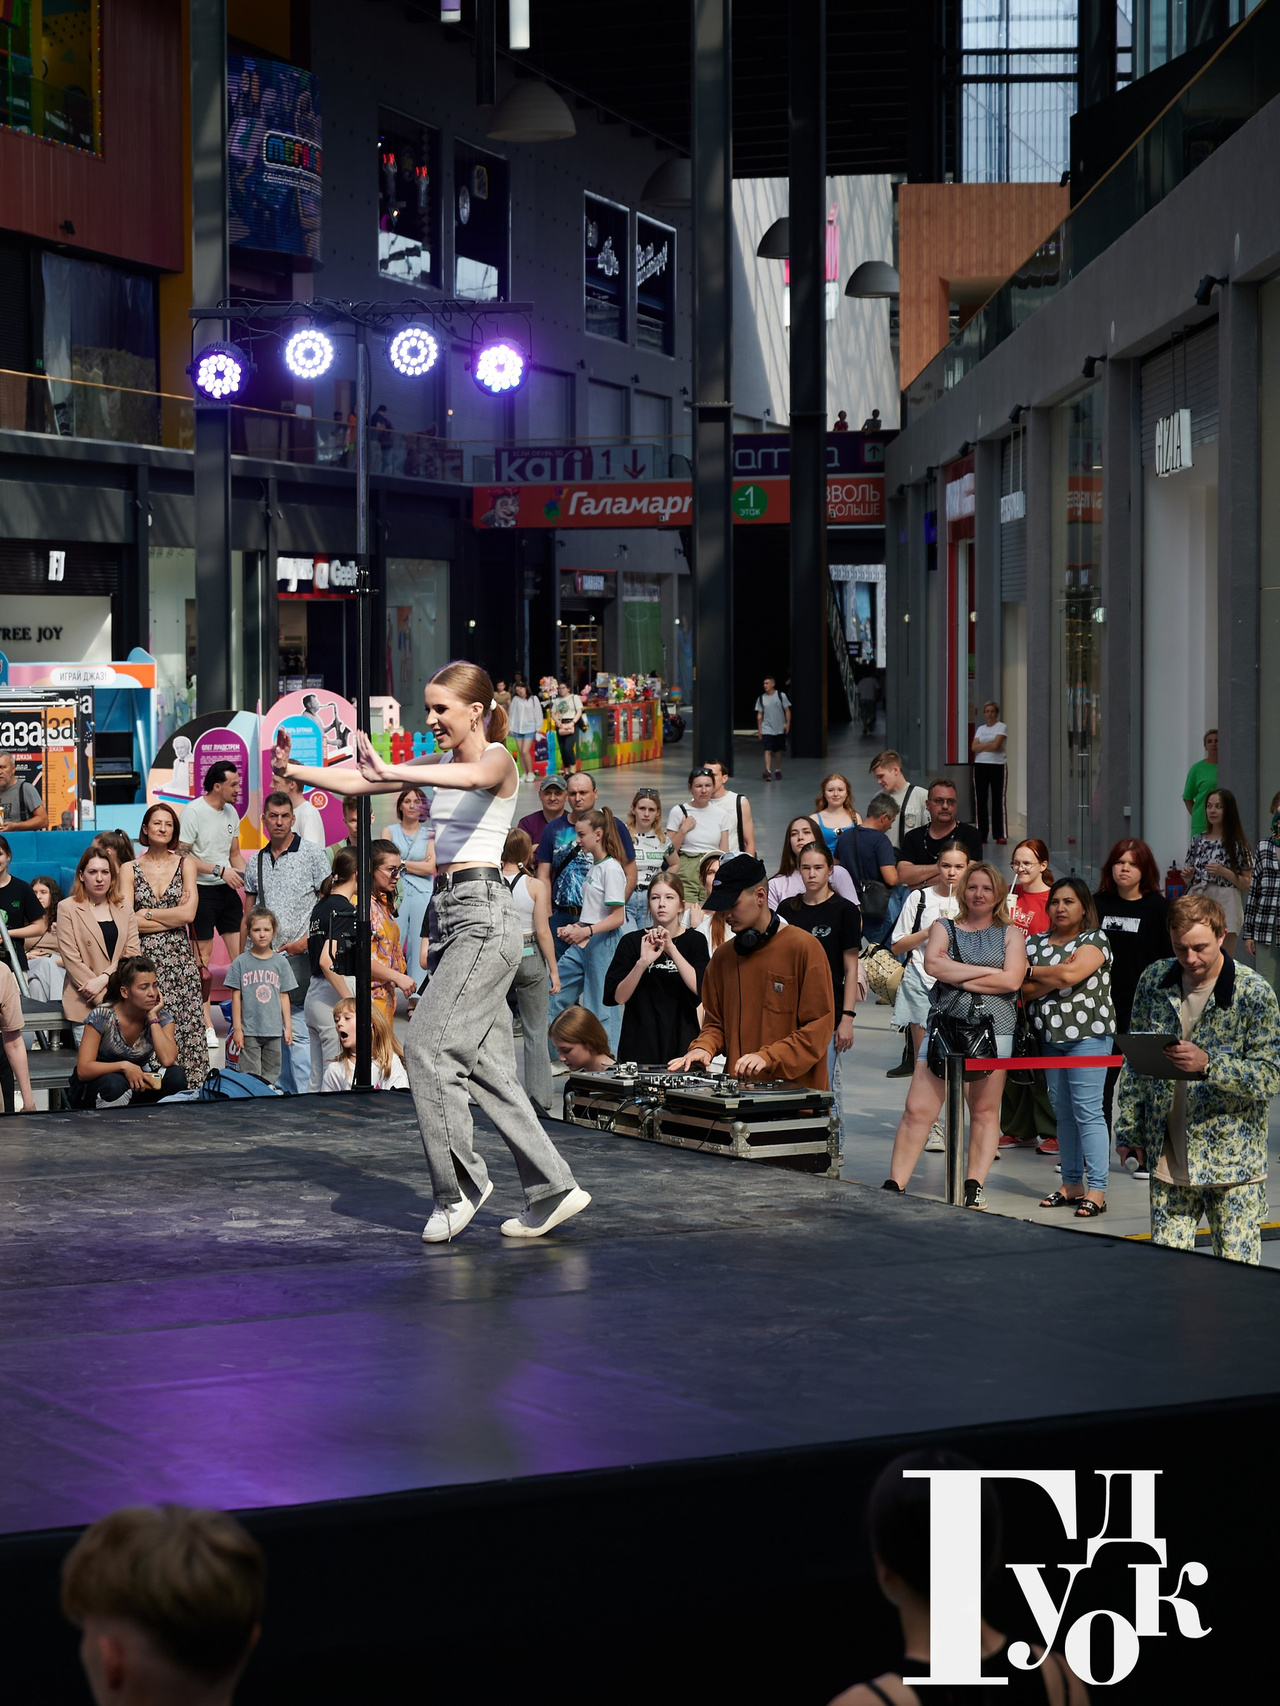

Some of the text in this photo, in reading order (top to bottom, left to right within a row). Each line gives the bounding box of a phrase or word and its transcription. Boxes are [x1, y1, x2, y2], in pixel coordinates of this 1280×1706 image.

[826, 484, 880, 503] ЗВОЛЬ
[36, 627, 63, 643] JOY
[59, 670, 107, 682] ИГРАЙ ДЖАЗ!
[242, 969, 265, 987] STAY
